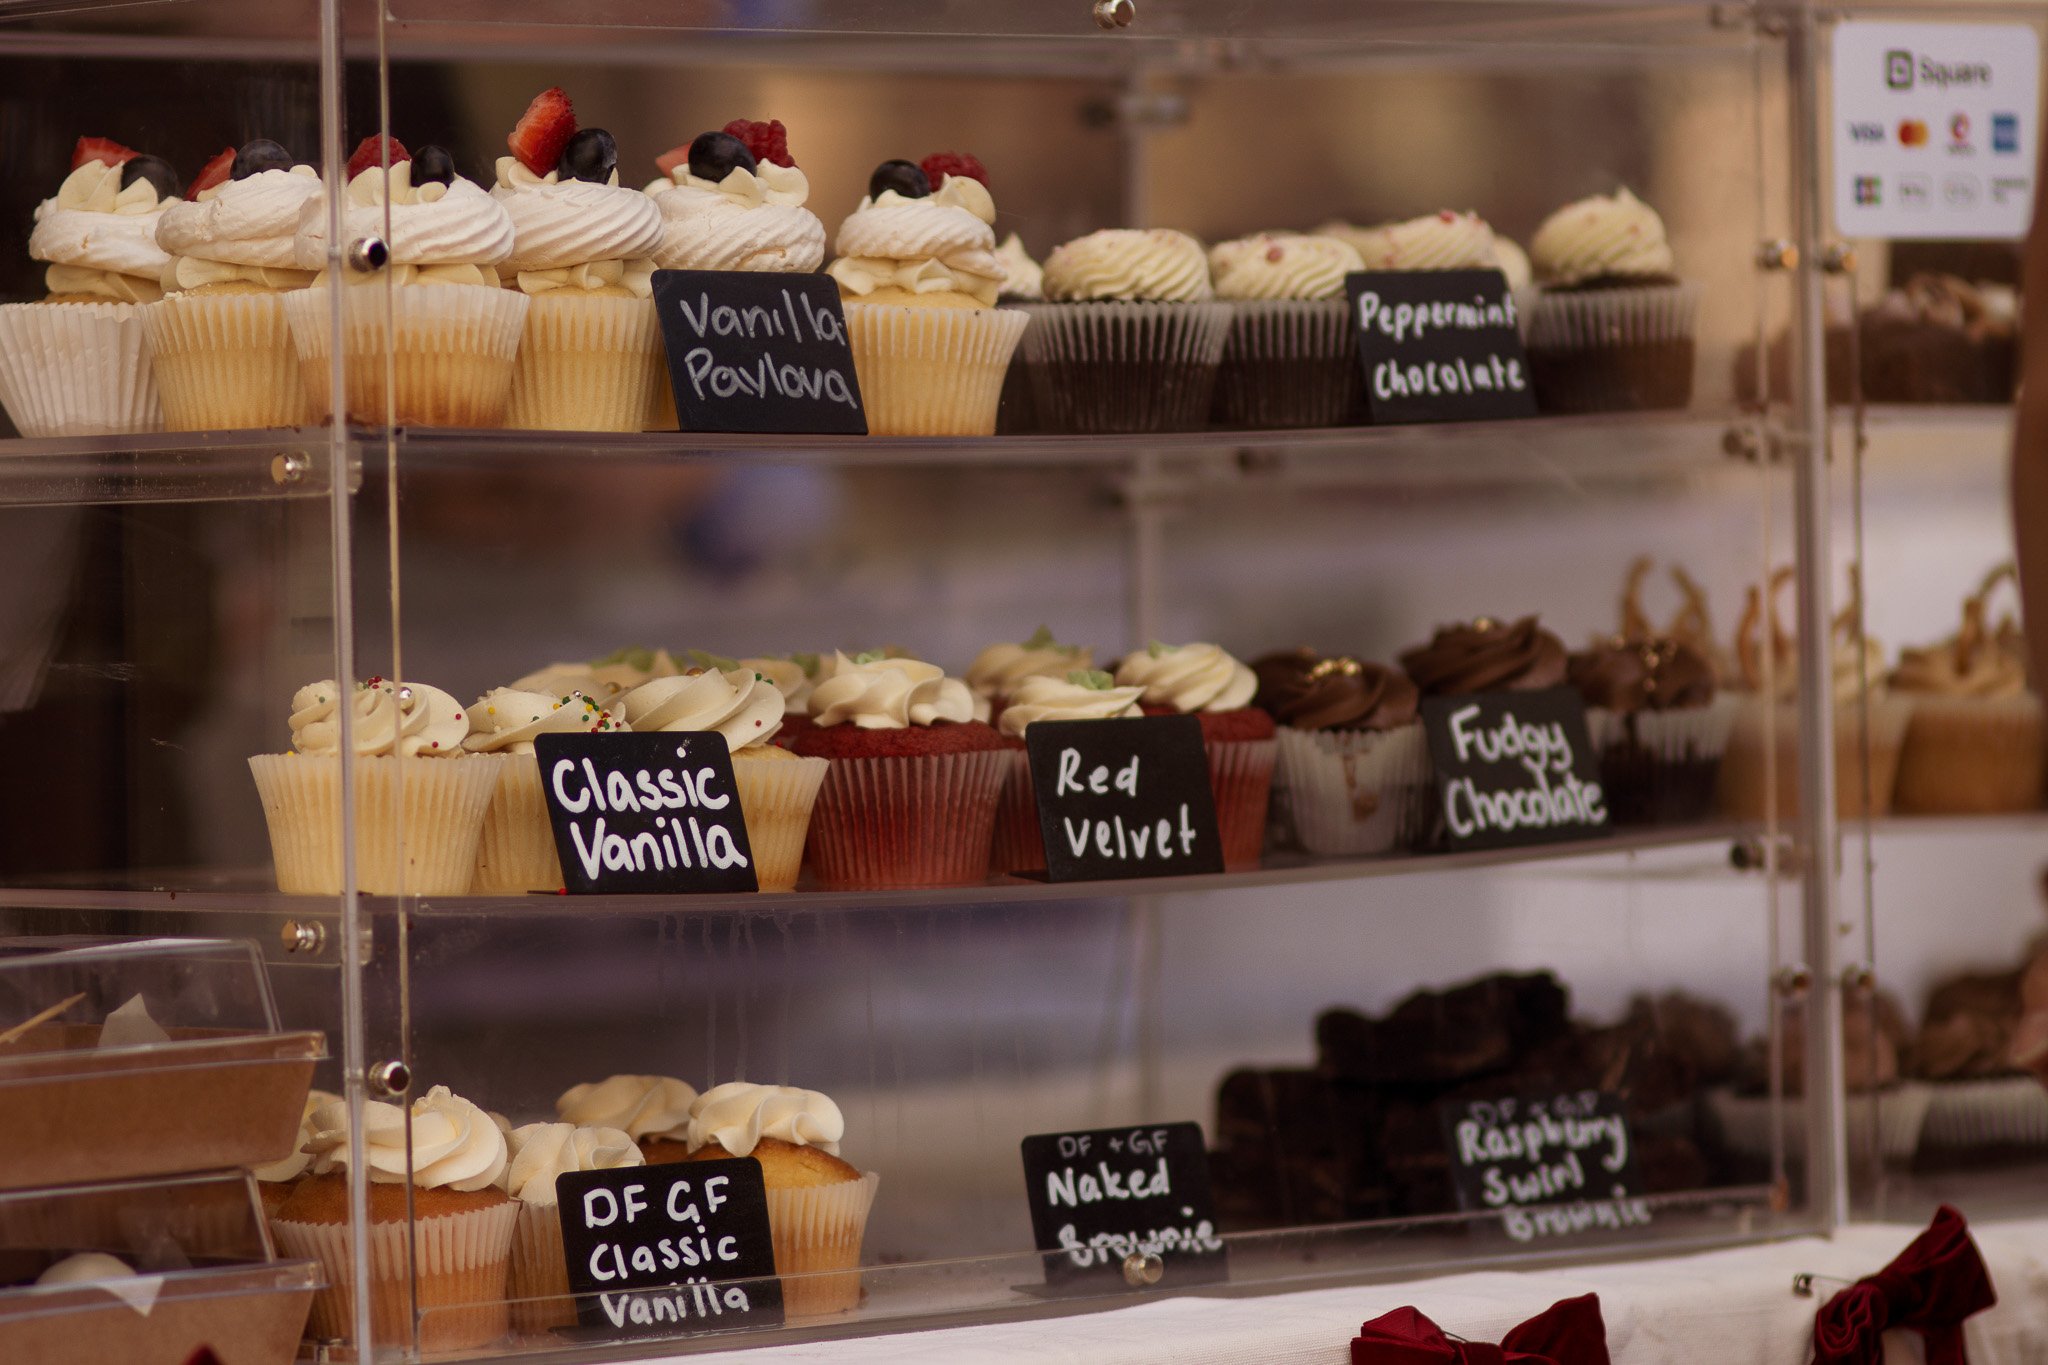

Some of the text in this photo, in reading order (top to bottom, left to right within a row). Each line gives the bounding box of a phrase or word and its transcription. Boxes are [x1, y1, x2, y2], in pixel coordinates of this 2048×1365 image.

[679, 288, 846, 346] Vanilla
[1358, 292, 1517, 343] Peppermint
[684, 347, 858, 409] Pavlova
[1374, 353, 1526, 400] Chocolate
[1450, 704, 1573, 772] Fudgy
[552, 747, 730, 813] Classic
[1057, 747, 1139, 797] Red
[1064, 803, 1196, 860] Velvet
[1446, 771, 1608, 837] Chocolate
[569, 816, 748, 880] Vanilla
[583, 1175, 729, 1228] DF GF
[1047, 1157, 1171, 1206] Naked
[589, 1225, 739, 1281] Classic
[600, 1276, 750, 1329] Vanilla
